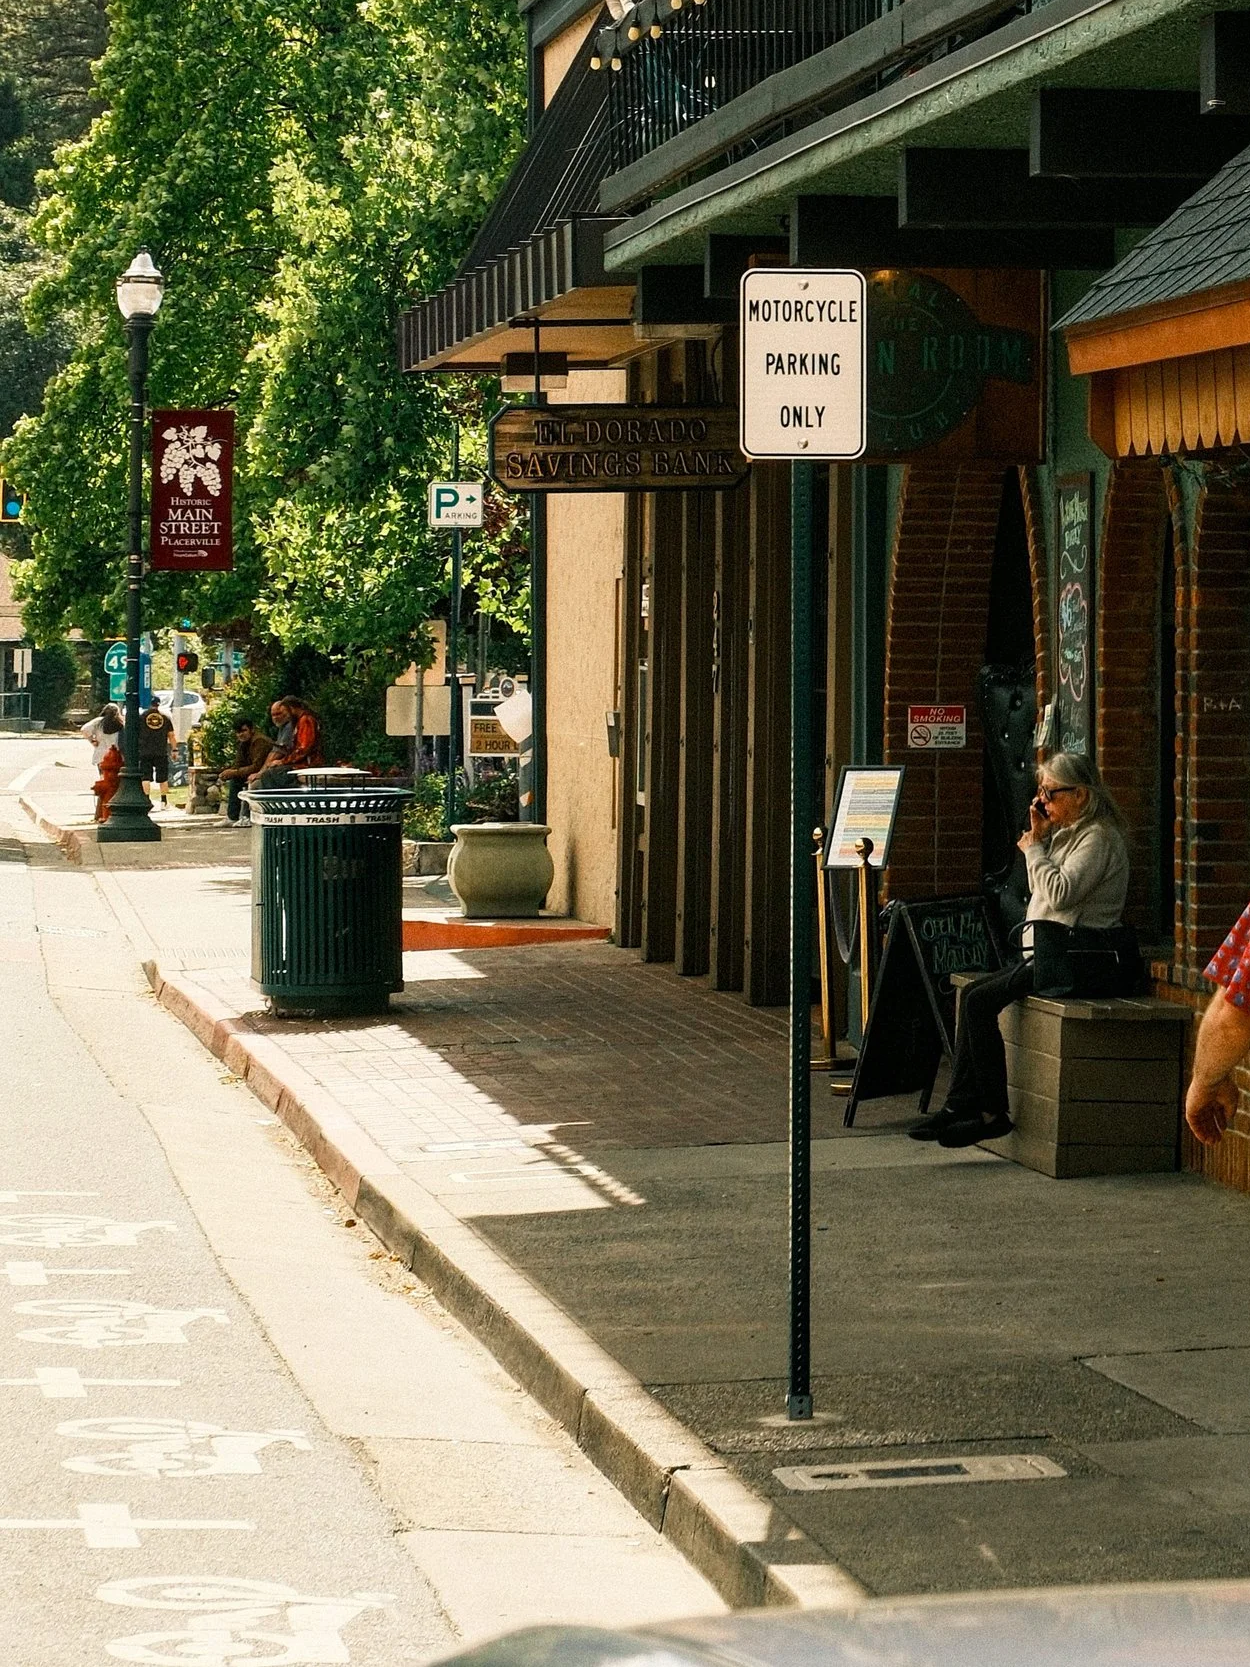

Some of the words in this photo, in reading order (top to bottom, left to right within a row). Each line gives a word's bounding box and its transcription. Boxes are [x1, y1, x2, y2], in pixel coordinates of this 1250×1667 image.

[749, 299, 858, 323] MOTORCYCLE
[765, 352, 841, 376] PARKING
[780, 405, 826, 428] ONLY
[534, 420, 575, 445] EL
[585, 418, 707, 444] DORADO
[506, 451, 641, 479] SAVINGS
[653, 450, 734, 476] BANK
[167, 508, 214, 521] MAIN
[159, 521, 222, 534] STREET
[913, 715, 961, 723] SMOKING
[473, 723, 497, 733] FREE
[485, 740, 511, 751] HOUR
[305, 816, 341, 824] TRASH
